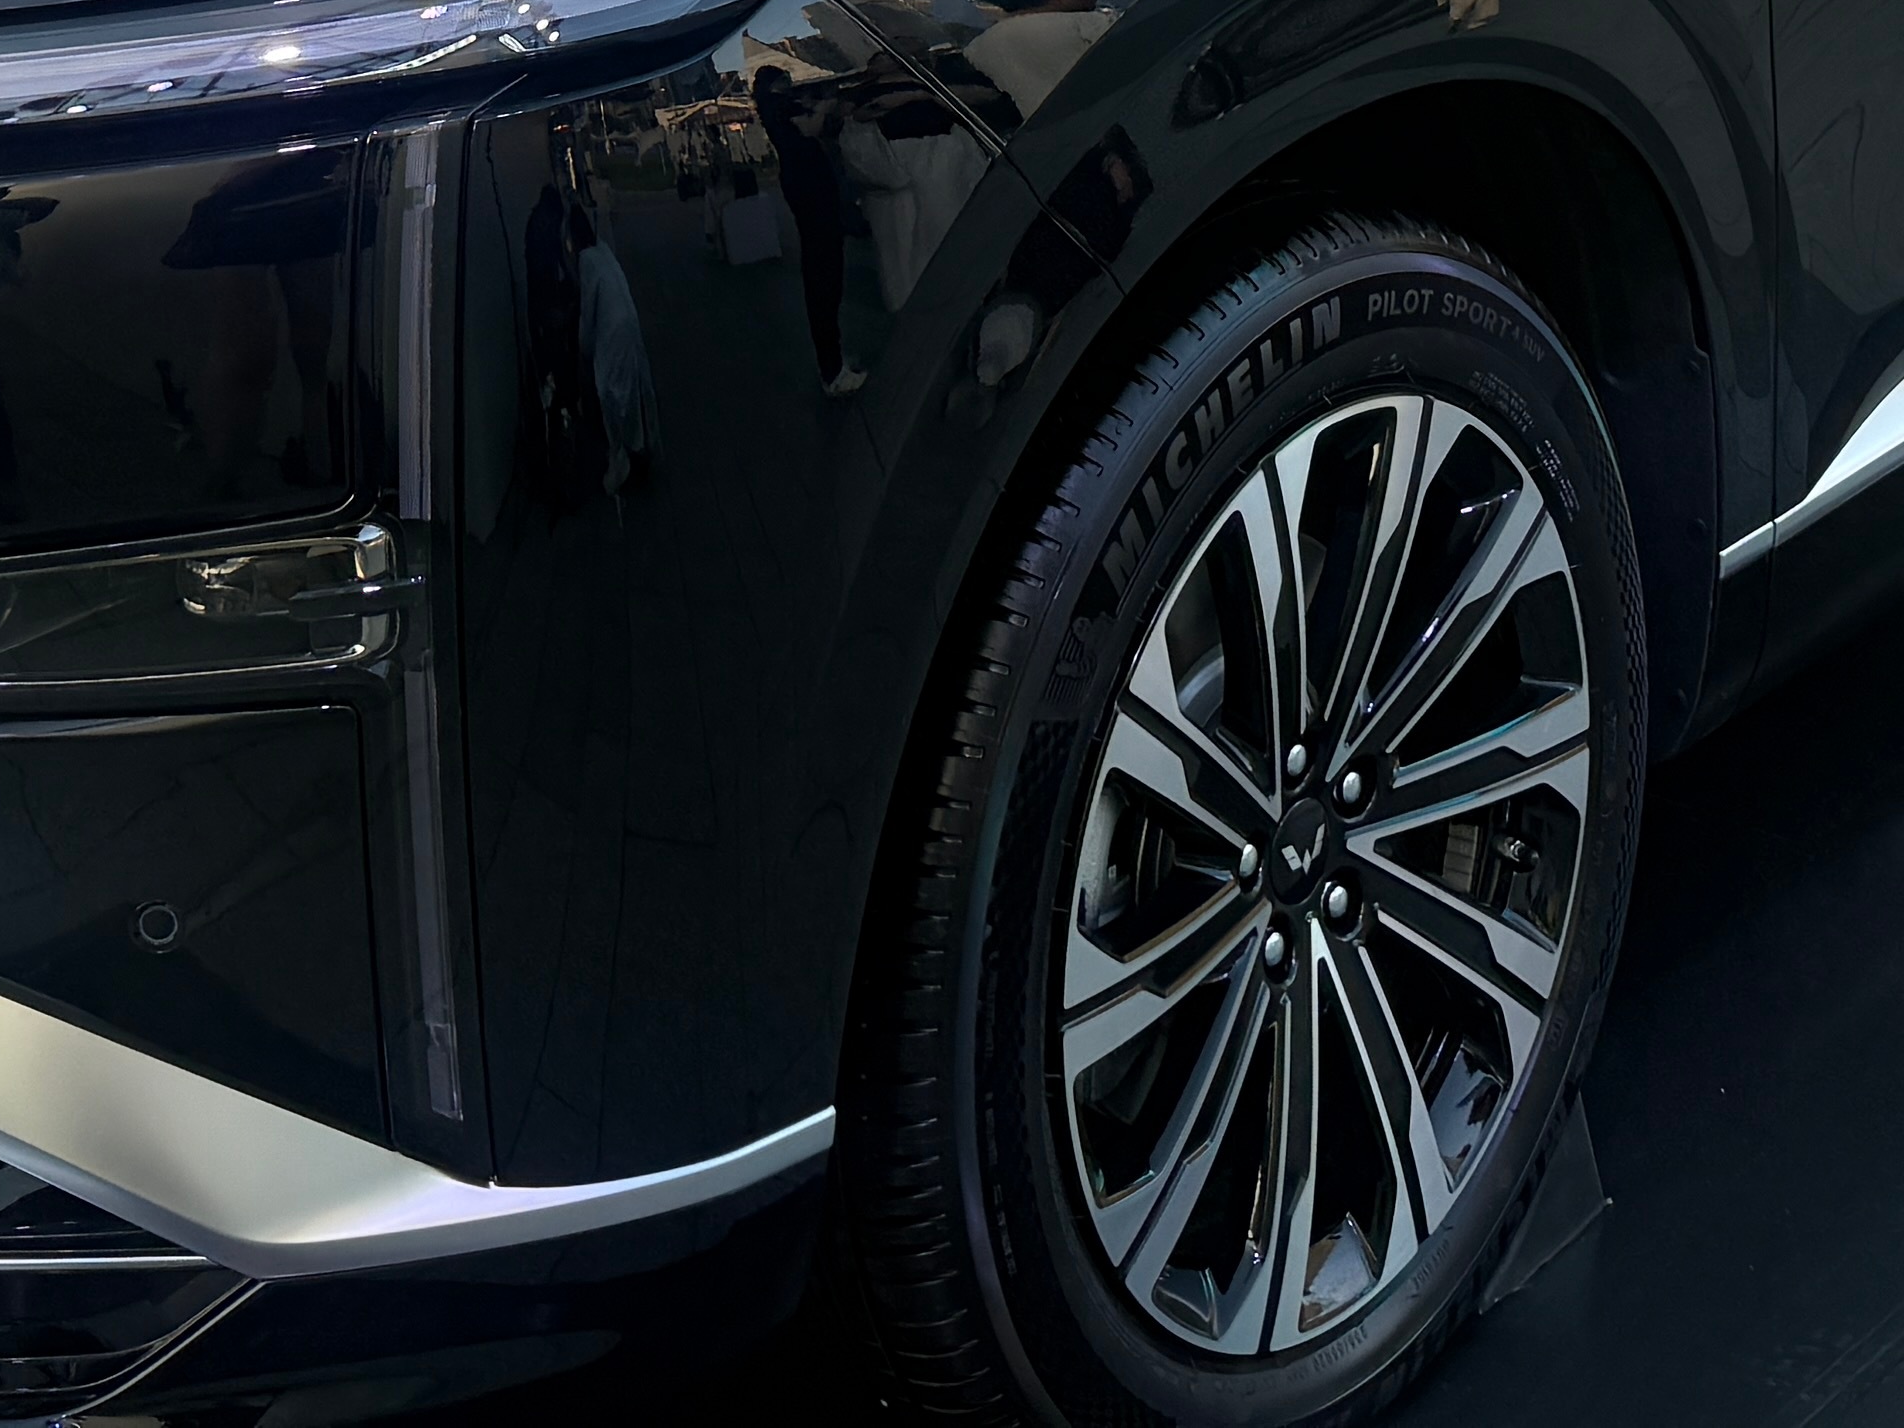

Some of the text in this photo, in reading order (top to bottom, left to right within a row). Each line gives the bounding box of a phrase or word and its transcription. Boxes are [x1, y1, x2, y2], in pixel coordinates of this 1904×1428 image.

[1366, 287, 1437, 323] PILOT
[1440, 290, 1512, 339] SPORT
[1100, 294, 1344, 599] MICHELIN
